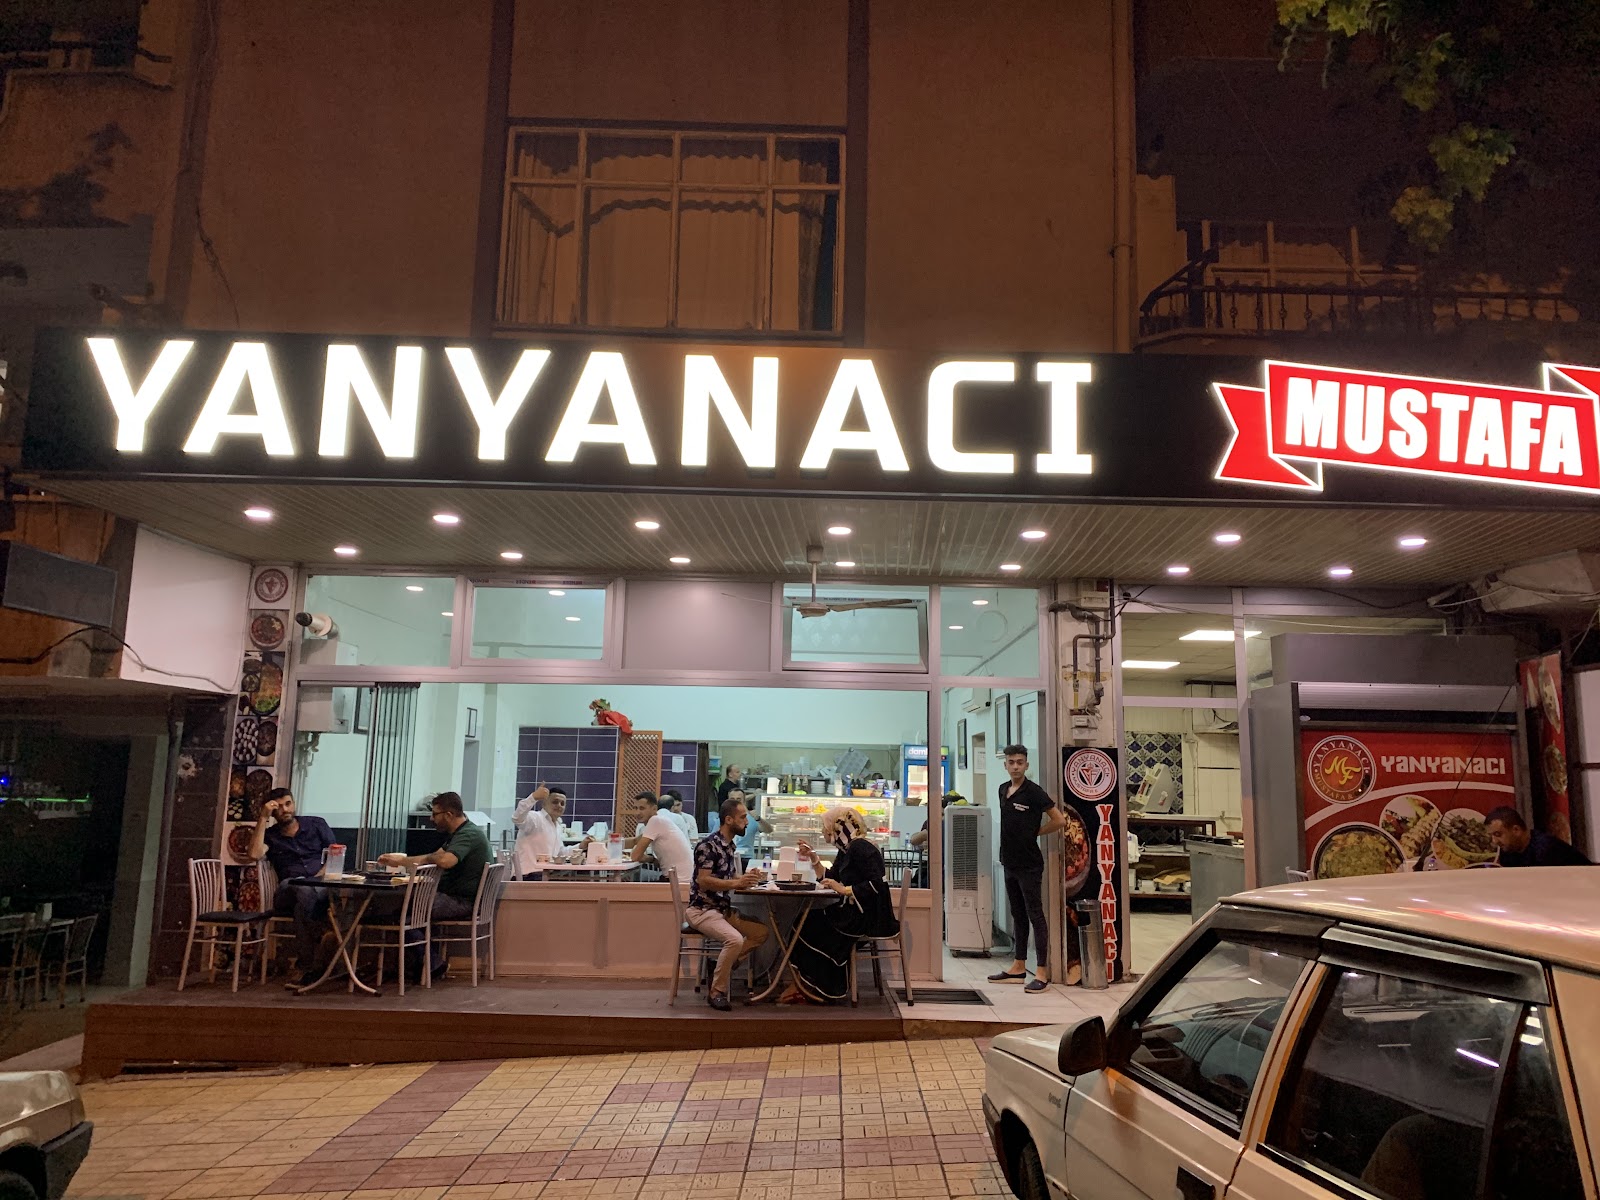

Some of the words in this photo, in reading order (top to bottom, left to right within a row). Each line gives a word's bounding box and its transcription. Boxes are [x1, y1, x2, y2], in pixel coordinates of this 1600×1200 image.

[86, 337, 1093, 475] YANYANACI
[1285, 376, 1584, 476] MUSTAFA
[1072, 755, 1109, 774] YANYANACI
[1313, 741, 1371, 770] YANYANACI
[1314, 773, 1346, 800] MUSTAFA
[1097, 804, 1117, 982] YANYANACI
